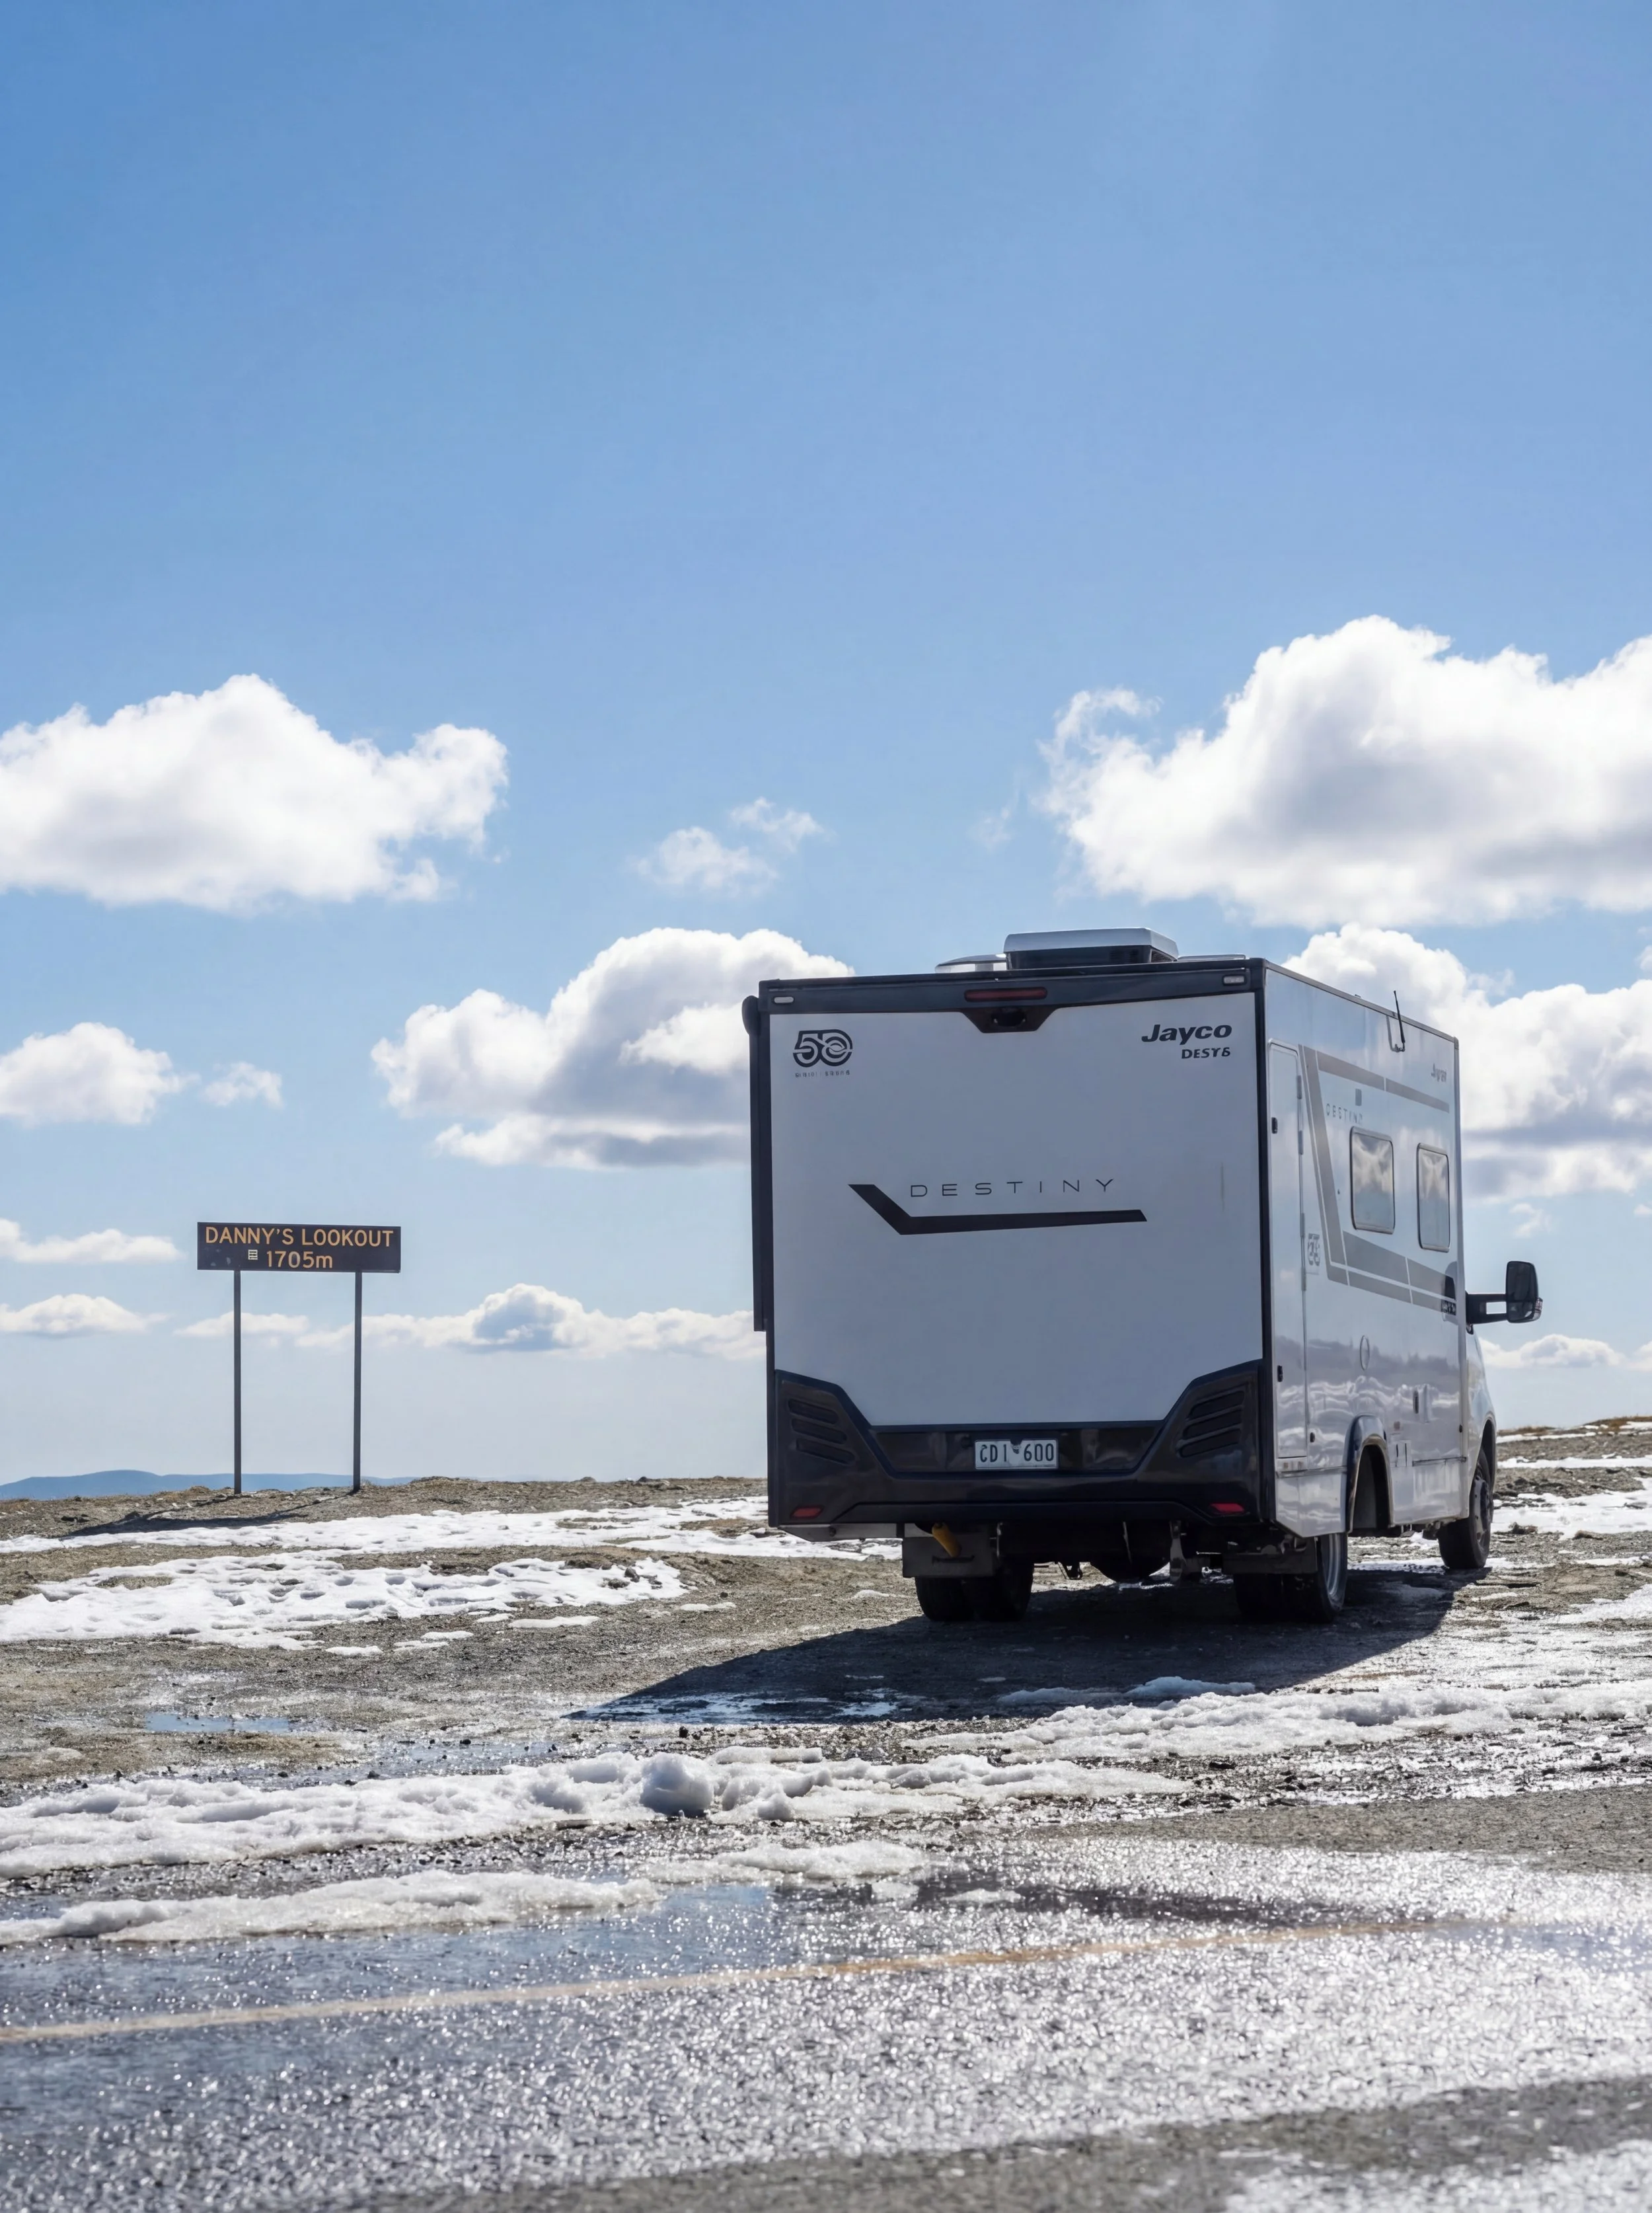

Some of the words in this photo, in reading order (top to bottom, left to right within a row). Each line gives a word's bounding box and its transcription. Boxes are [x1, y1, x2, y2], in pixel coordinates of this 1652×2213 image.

[1141, 1024, 1232, 1045] Jayco
[911, 1179, 1114, 1198] DESTINY
[206, 1227, 294, 1245] DANNY'S
[301, 1229, 394, 1247] LOOKOUT
[267, 1251, 333, 1268] 1705m
[1024, 1443, 1055, 1461] 600
